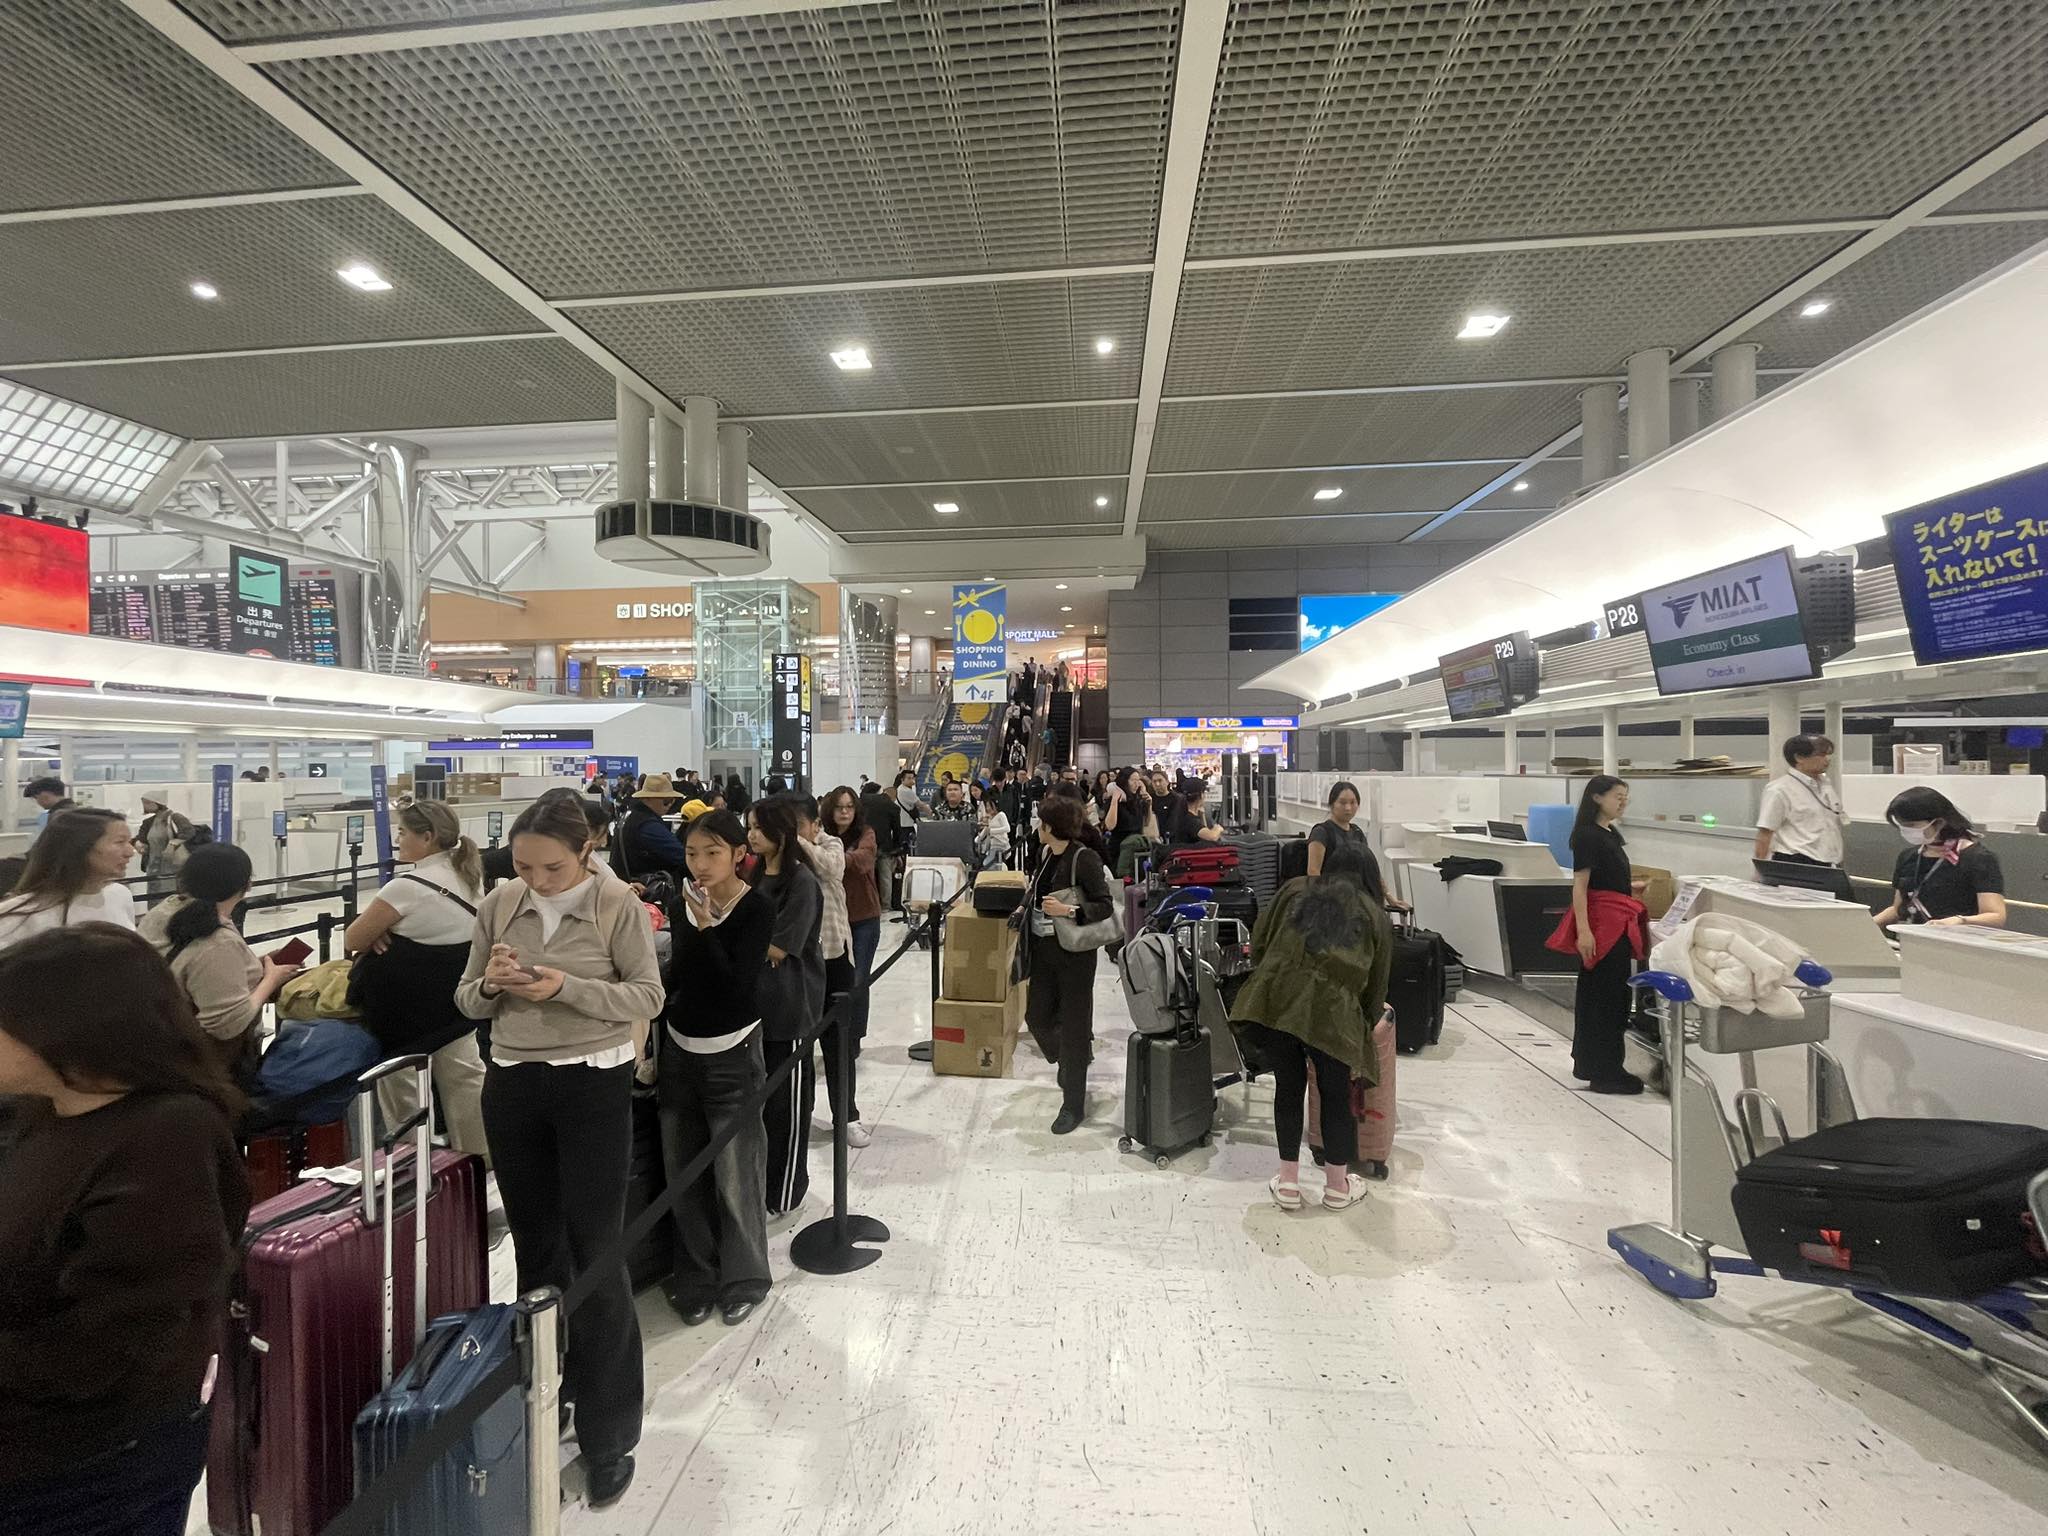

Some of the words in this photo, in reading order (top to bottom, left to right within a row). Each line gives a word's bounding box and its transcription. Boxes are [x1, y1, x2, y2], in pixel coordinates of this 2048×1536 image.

[1913, 506, 2004, 544] ライターは
[1701, 575, 1762, 614] MIAT
[236, 615, 284, 630] Departures
[1607, 604, 1639, 630] P28
[1033, 630, 1058, 638] MALL
[956, 646, 1004, 654] SHOPPING
[1494, 640, 1514, 660] P29
[1682, 638, 1729, 656] Economy
[1730, 632, 1761, 648] Class
[963, 660, 997, 668] DINING
[1706, 666, 1734, 678] Check
[1736, 665, 1745, 674] in
[980, 690, 994, 701] 4F
[950, 723, 989, 731] SHOPPING
